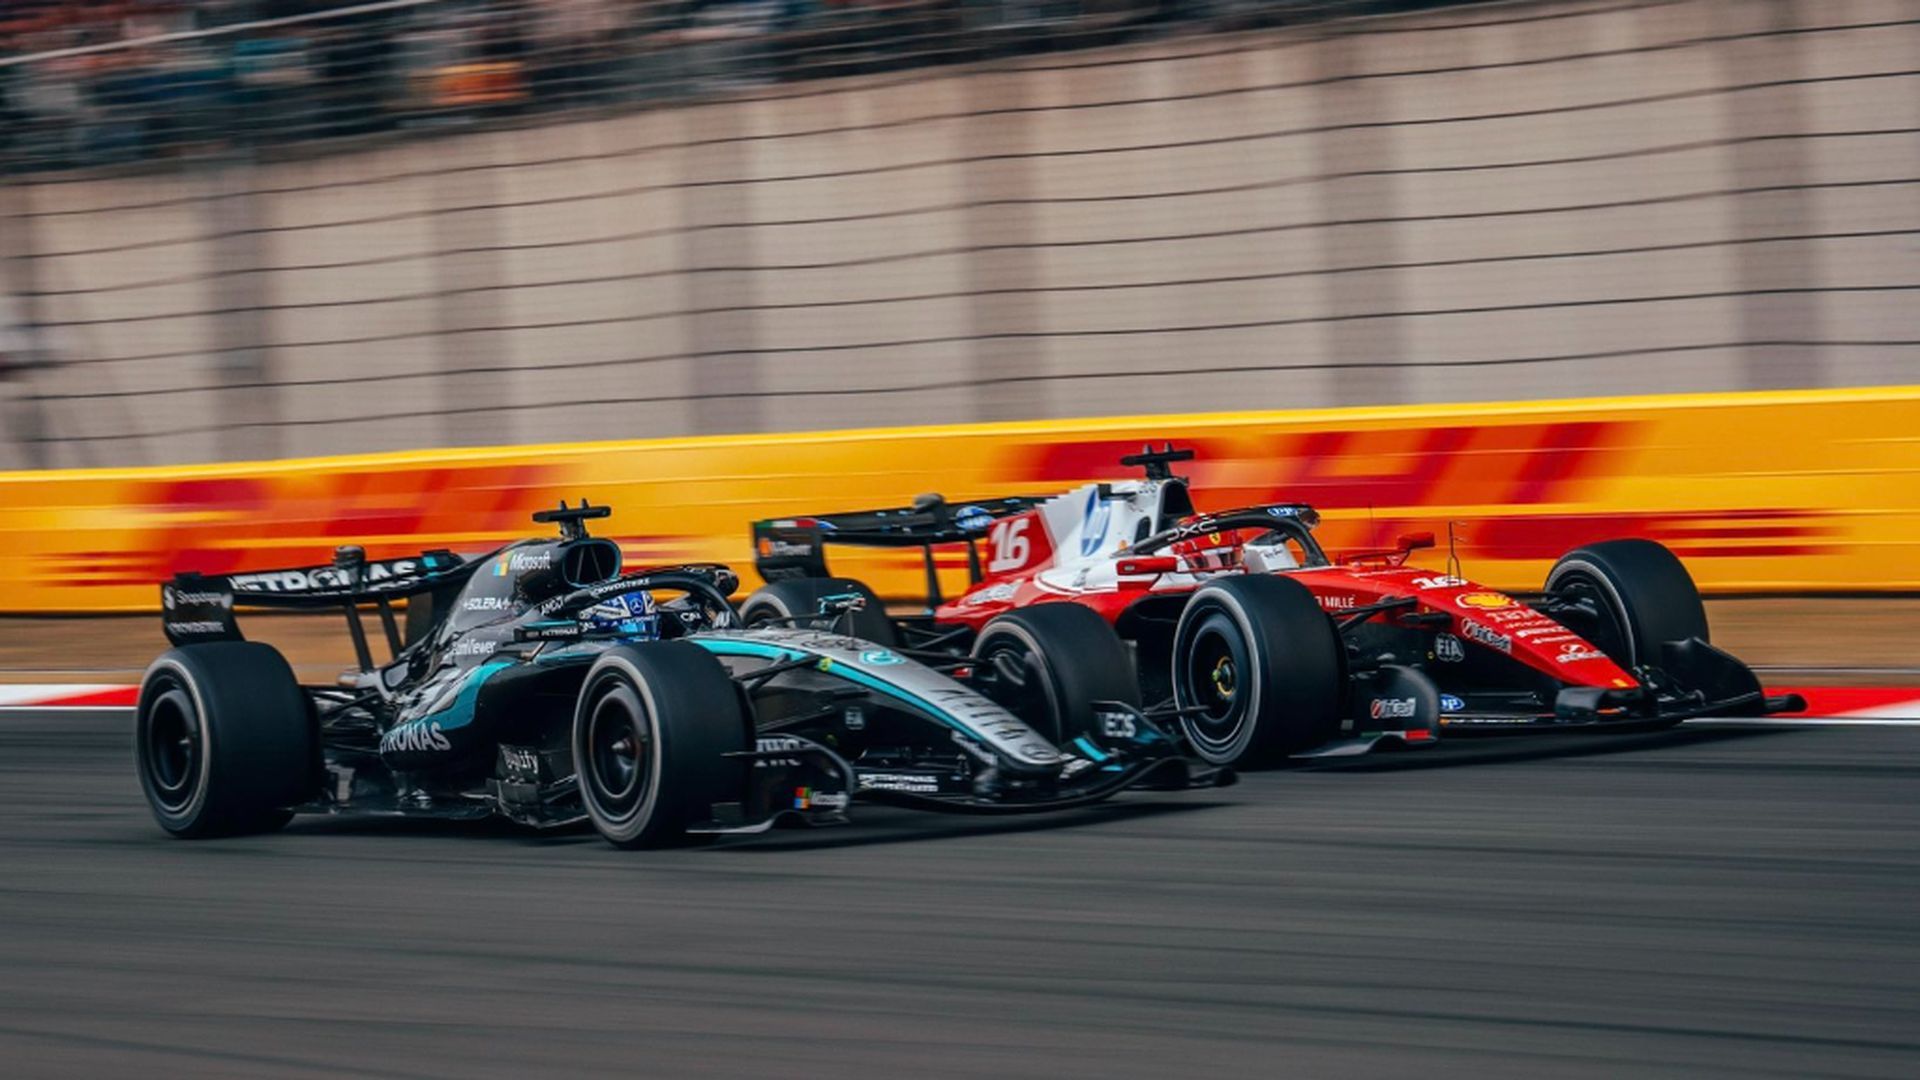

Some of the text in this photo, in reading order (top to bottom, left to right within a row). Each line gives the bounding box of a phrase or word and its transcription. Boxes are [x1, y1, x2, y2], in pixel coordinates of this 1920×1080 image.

[988, 518, 1030, 572] 16
[508, 550, 551, 571] Microsoft
[1412, 576, 1468, 590] 16
[1436, 639, 1461, 656] FIA
